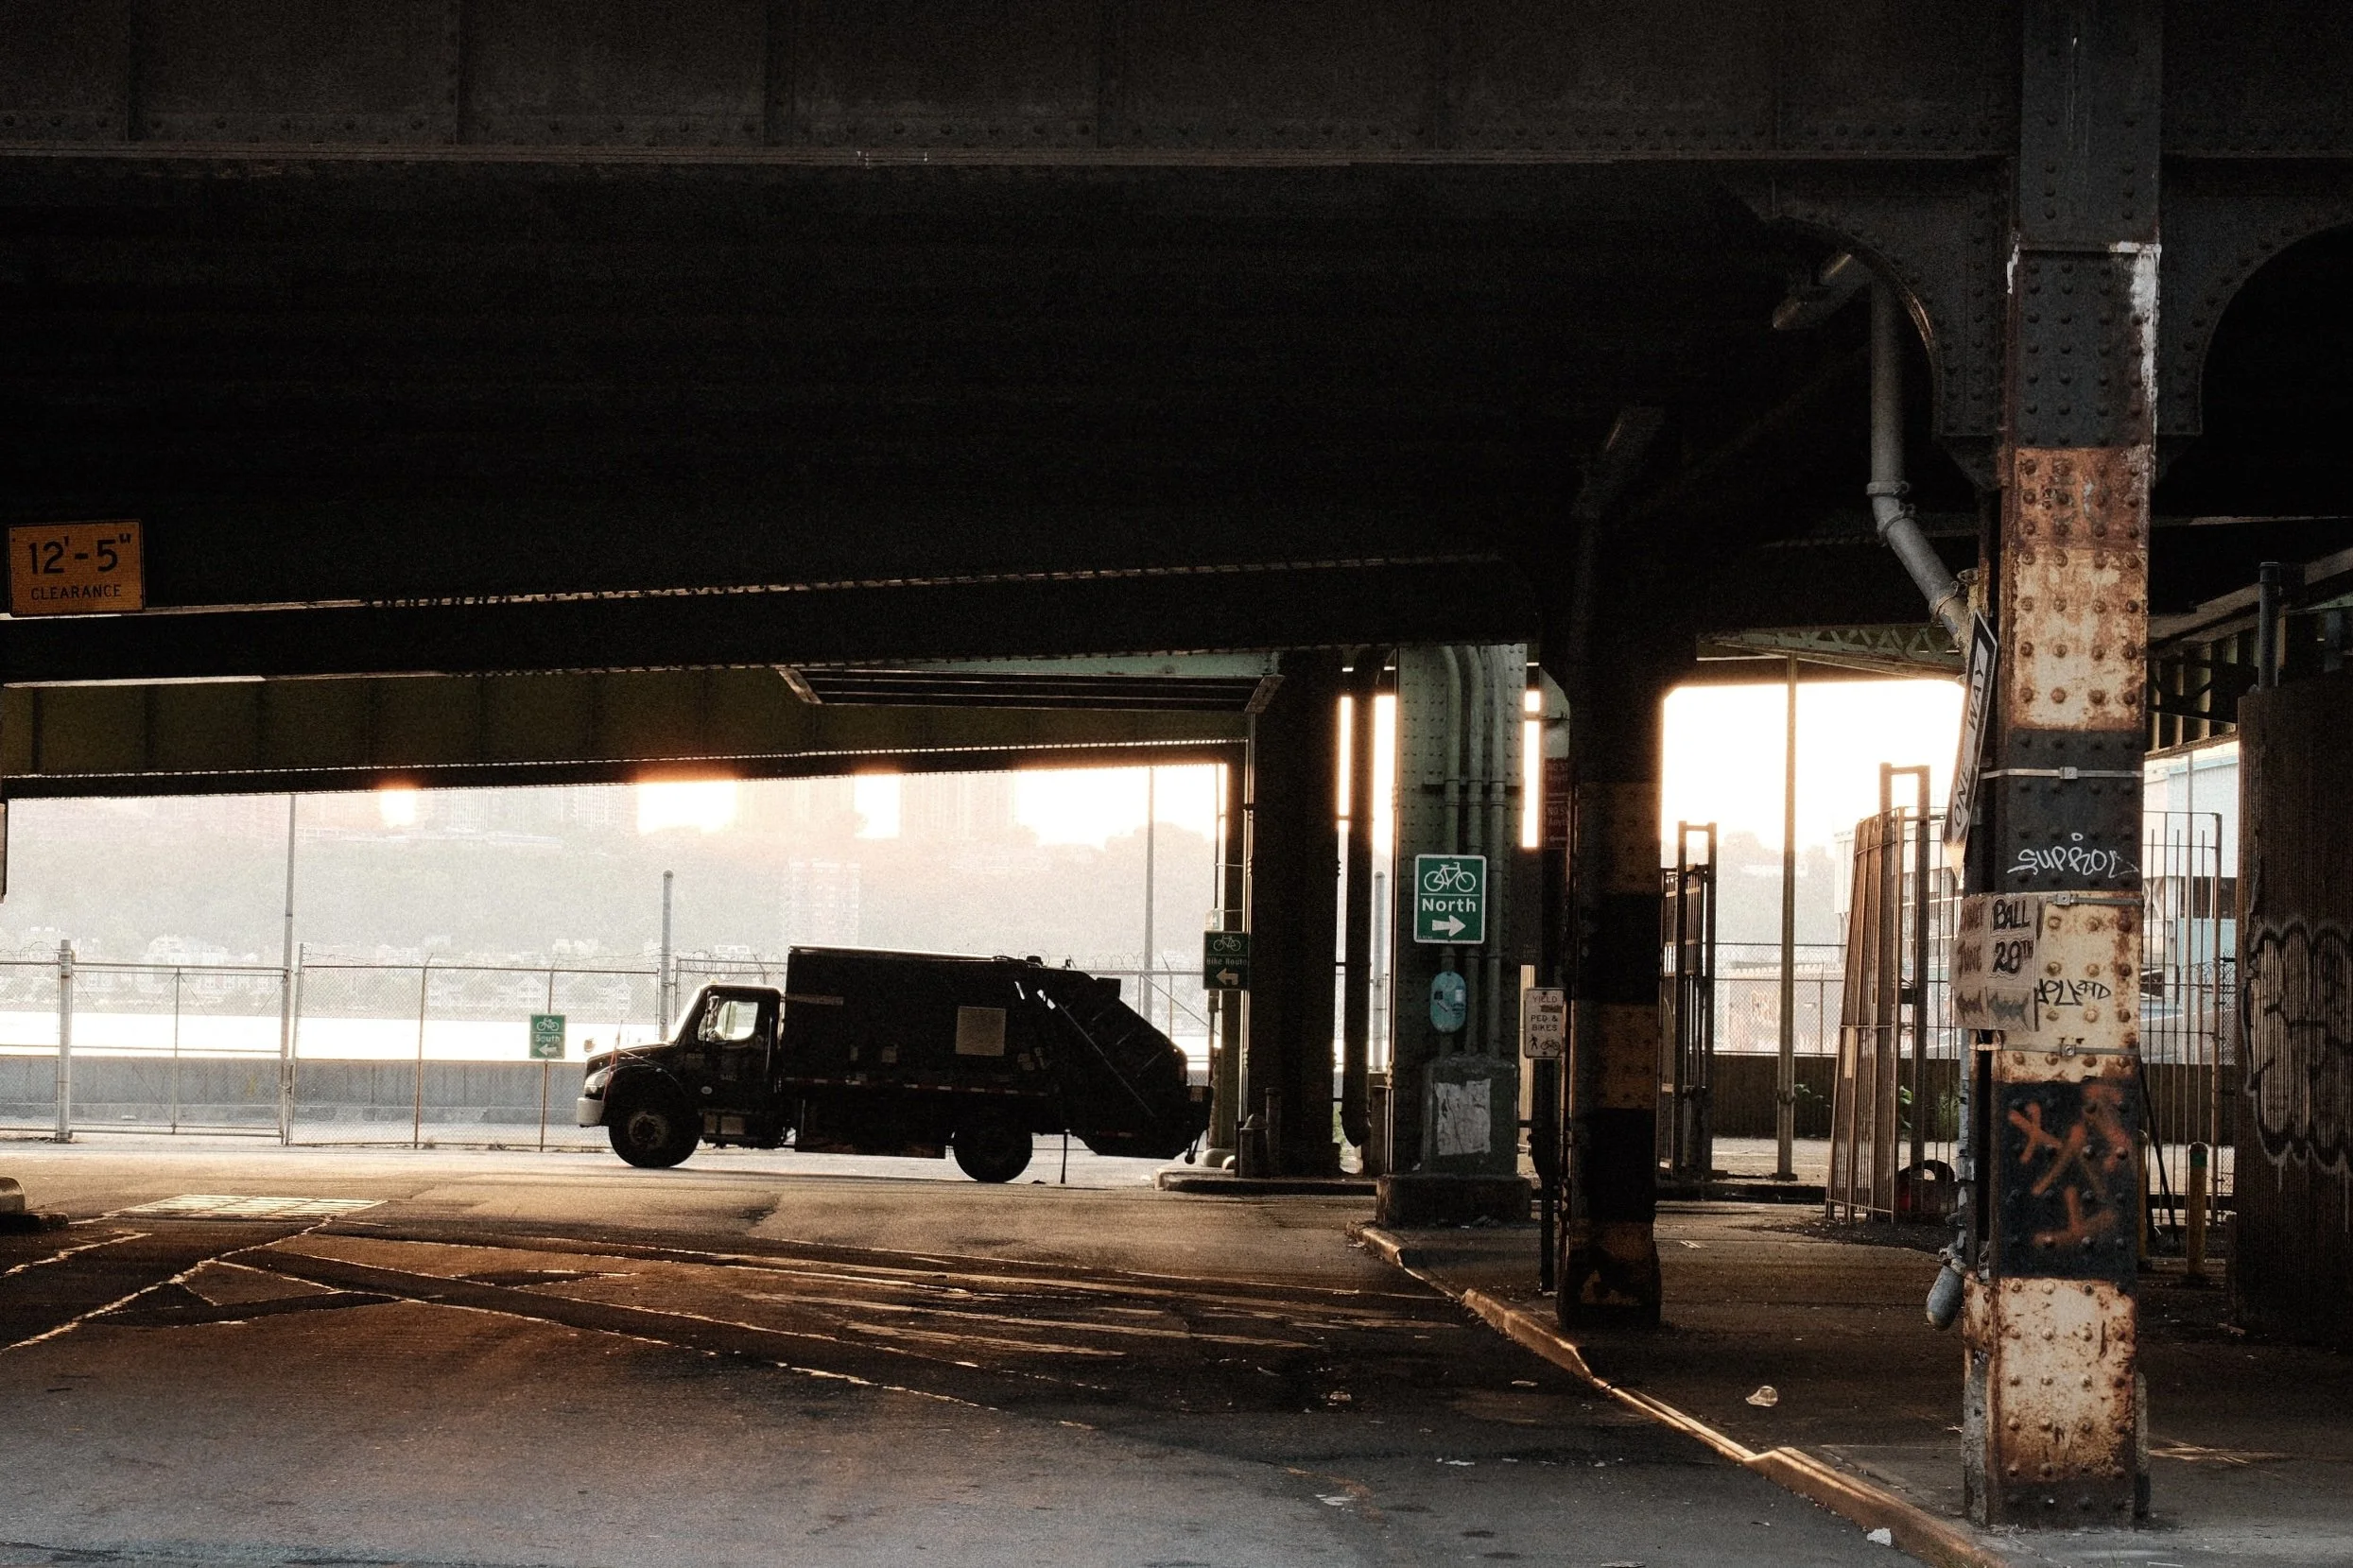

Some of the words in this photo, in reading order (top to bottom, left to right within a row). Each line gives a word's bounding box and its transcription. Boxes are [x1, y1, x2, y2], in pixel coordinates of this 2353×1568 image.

[28, 533, 131, 575] 12'-5"
[30, 584, 122, 601] CLEARANCE
[1954, 760, 1971, 829] ONE
[1968, 655, 1984, 732] WAY
[1422, 898, 1477, 913] North
[1532, 995, 1558, 1004] YIELD
[1531, 1024, 1558, 1032] BIKES
[535, 1034, 560, 1042] South
